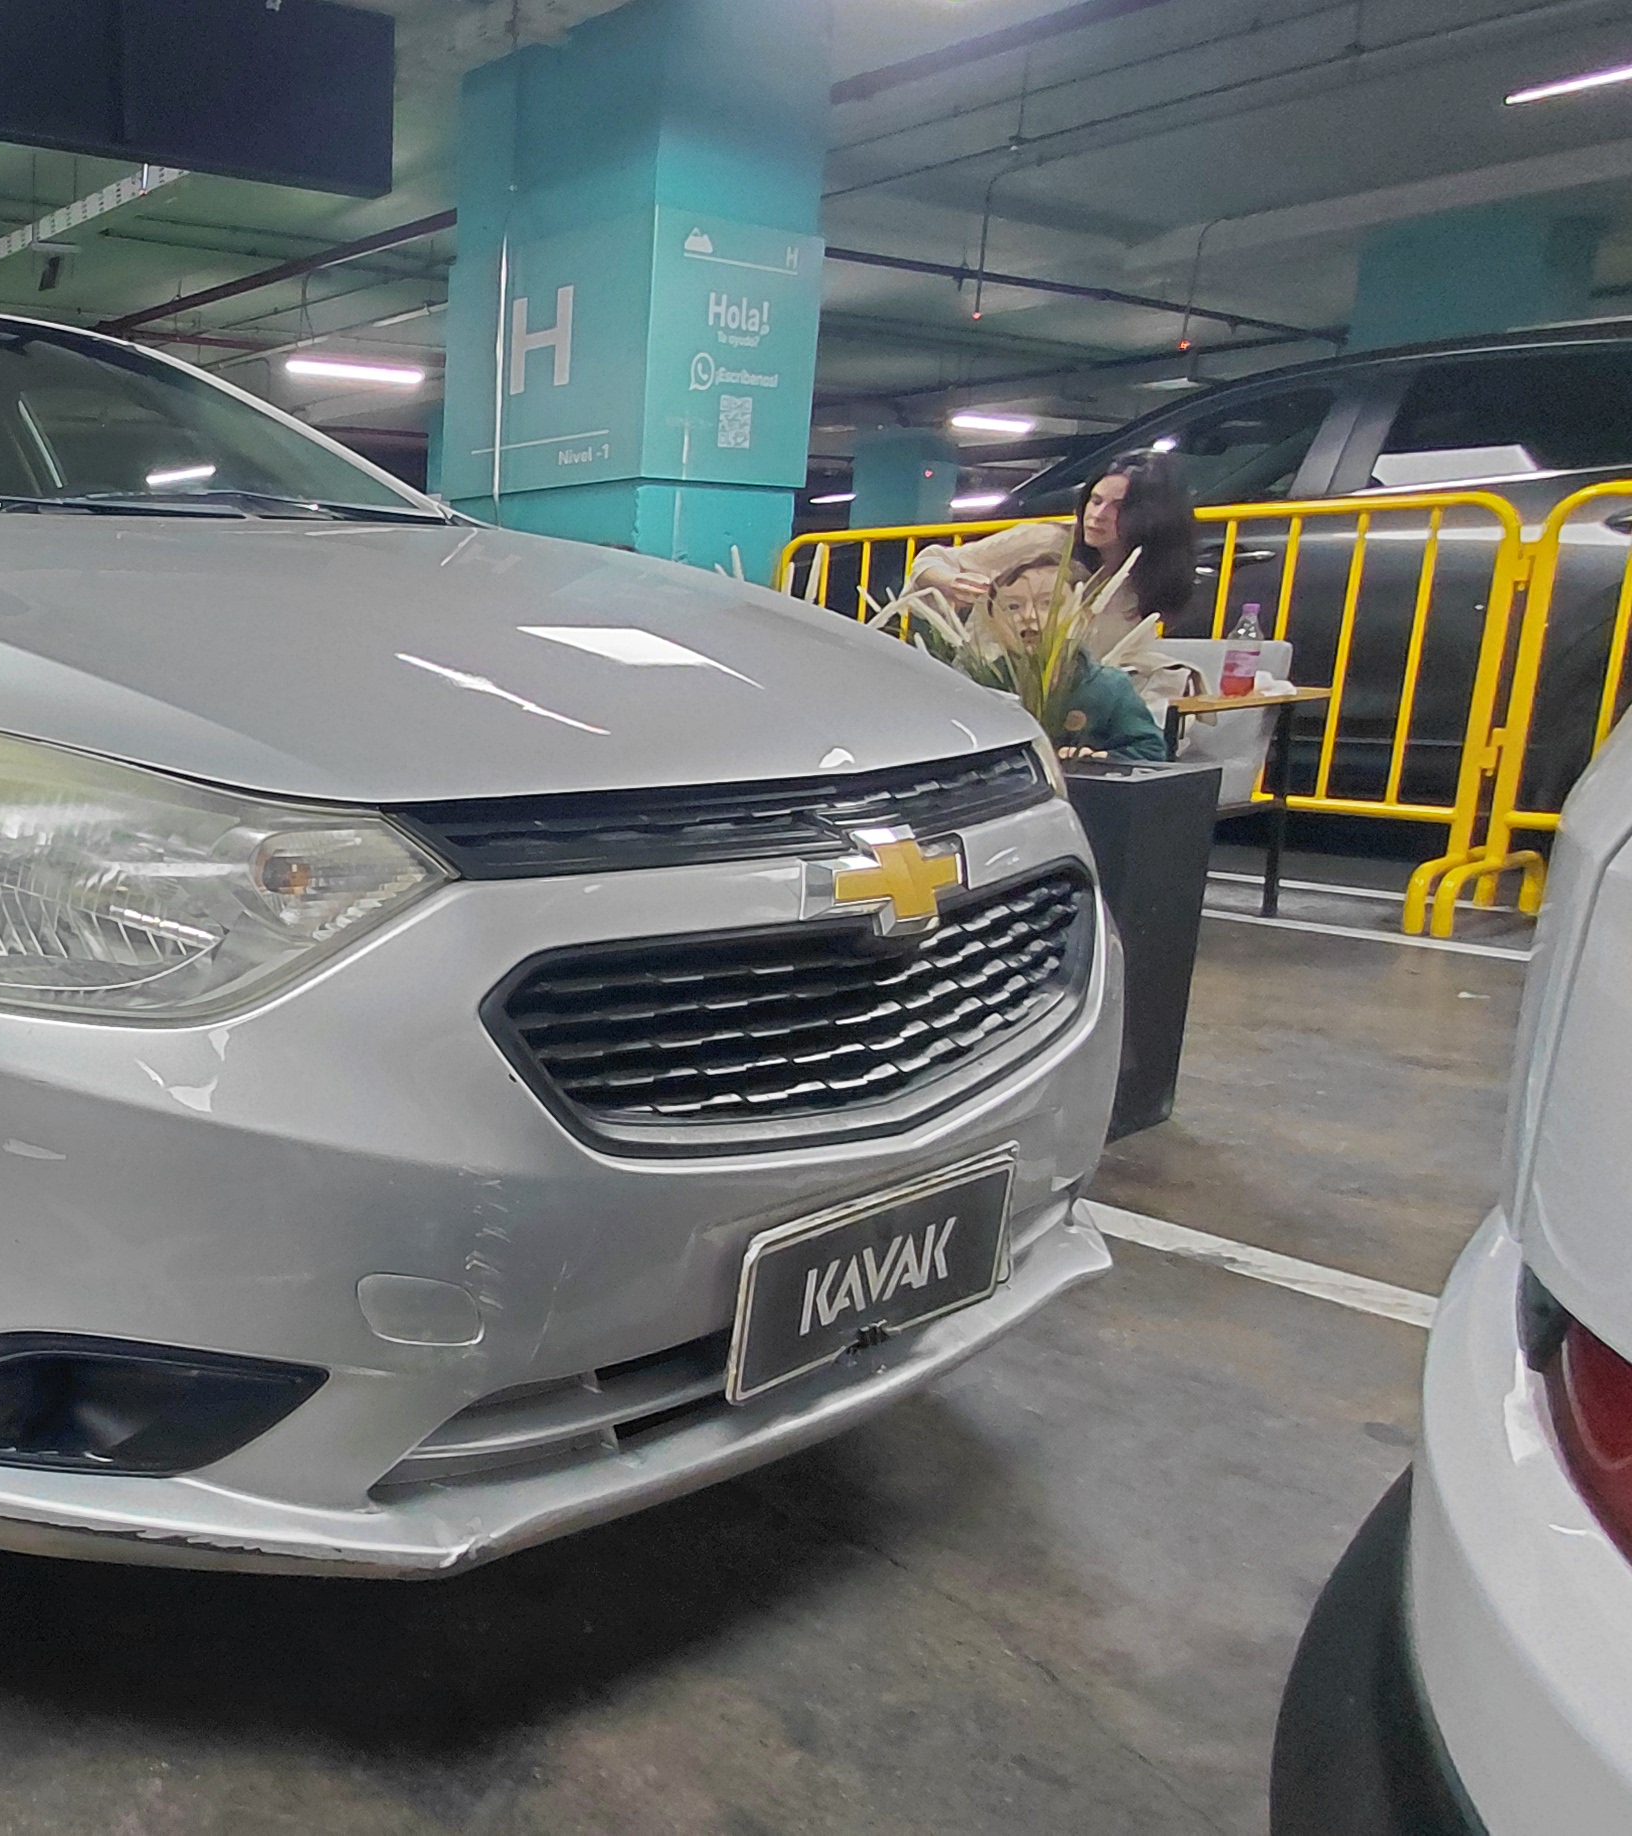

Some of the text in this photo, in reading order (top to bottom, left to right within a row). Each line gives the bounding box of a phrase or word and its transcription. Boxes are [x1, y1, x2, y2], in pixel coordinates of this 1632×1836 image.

[509, 285, 575, 396] H
[708, 291, 770, 336] Hola!
[558, 443, 610, 467] Nivel -1
[798, 1216, 958, 1337] KAVAK
